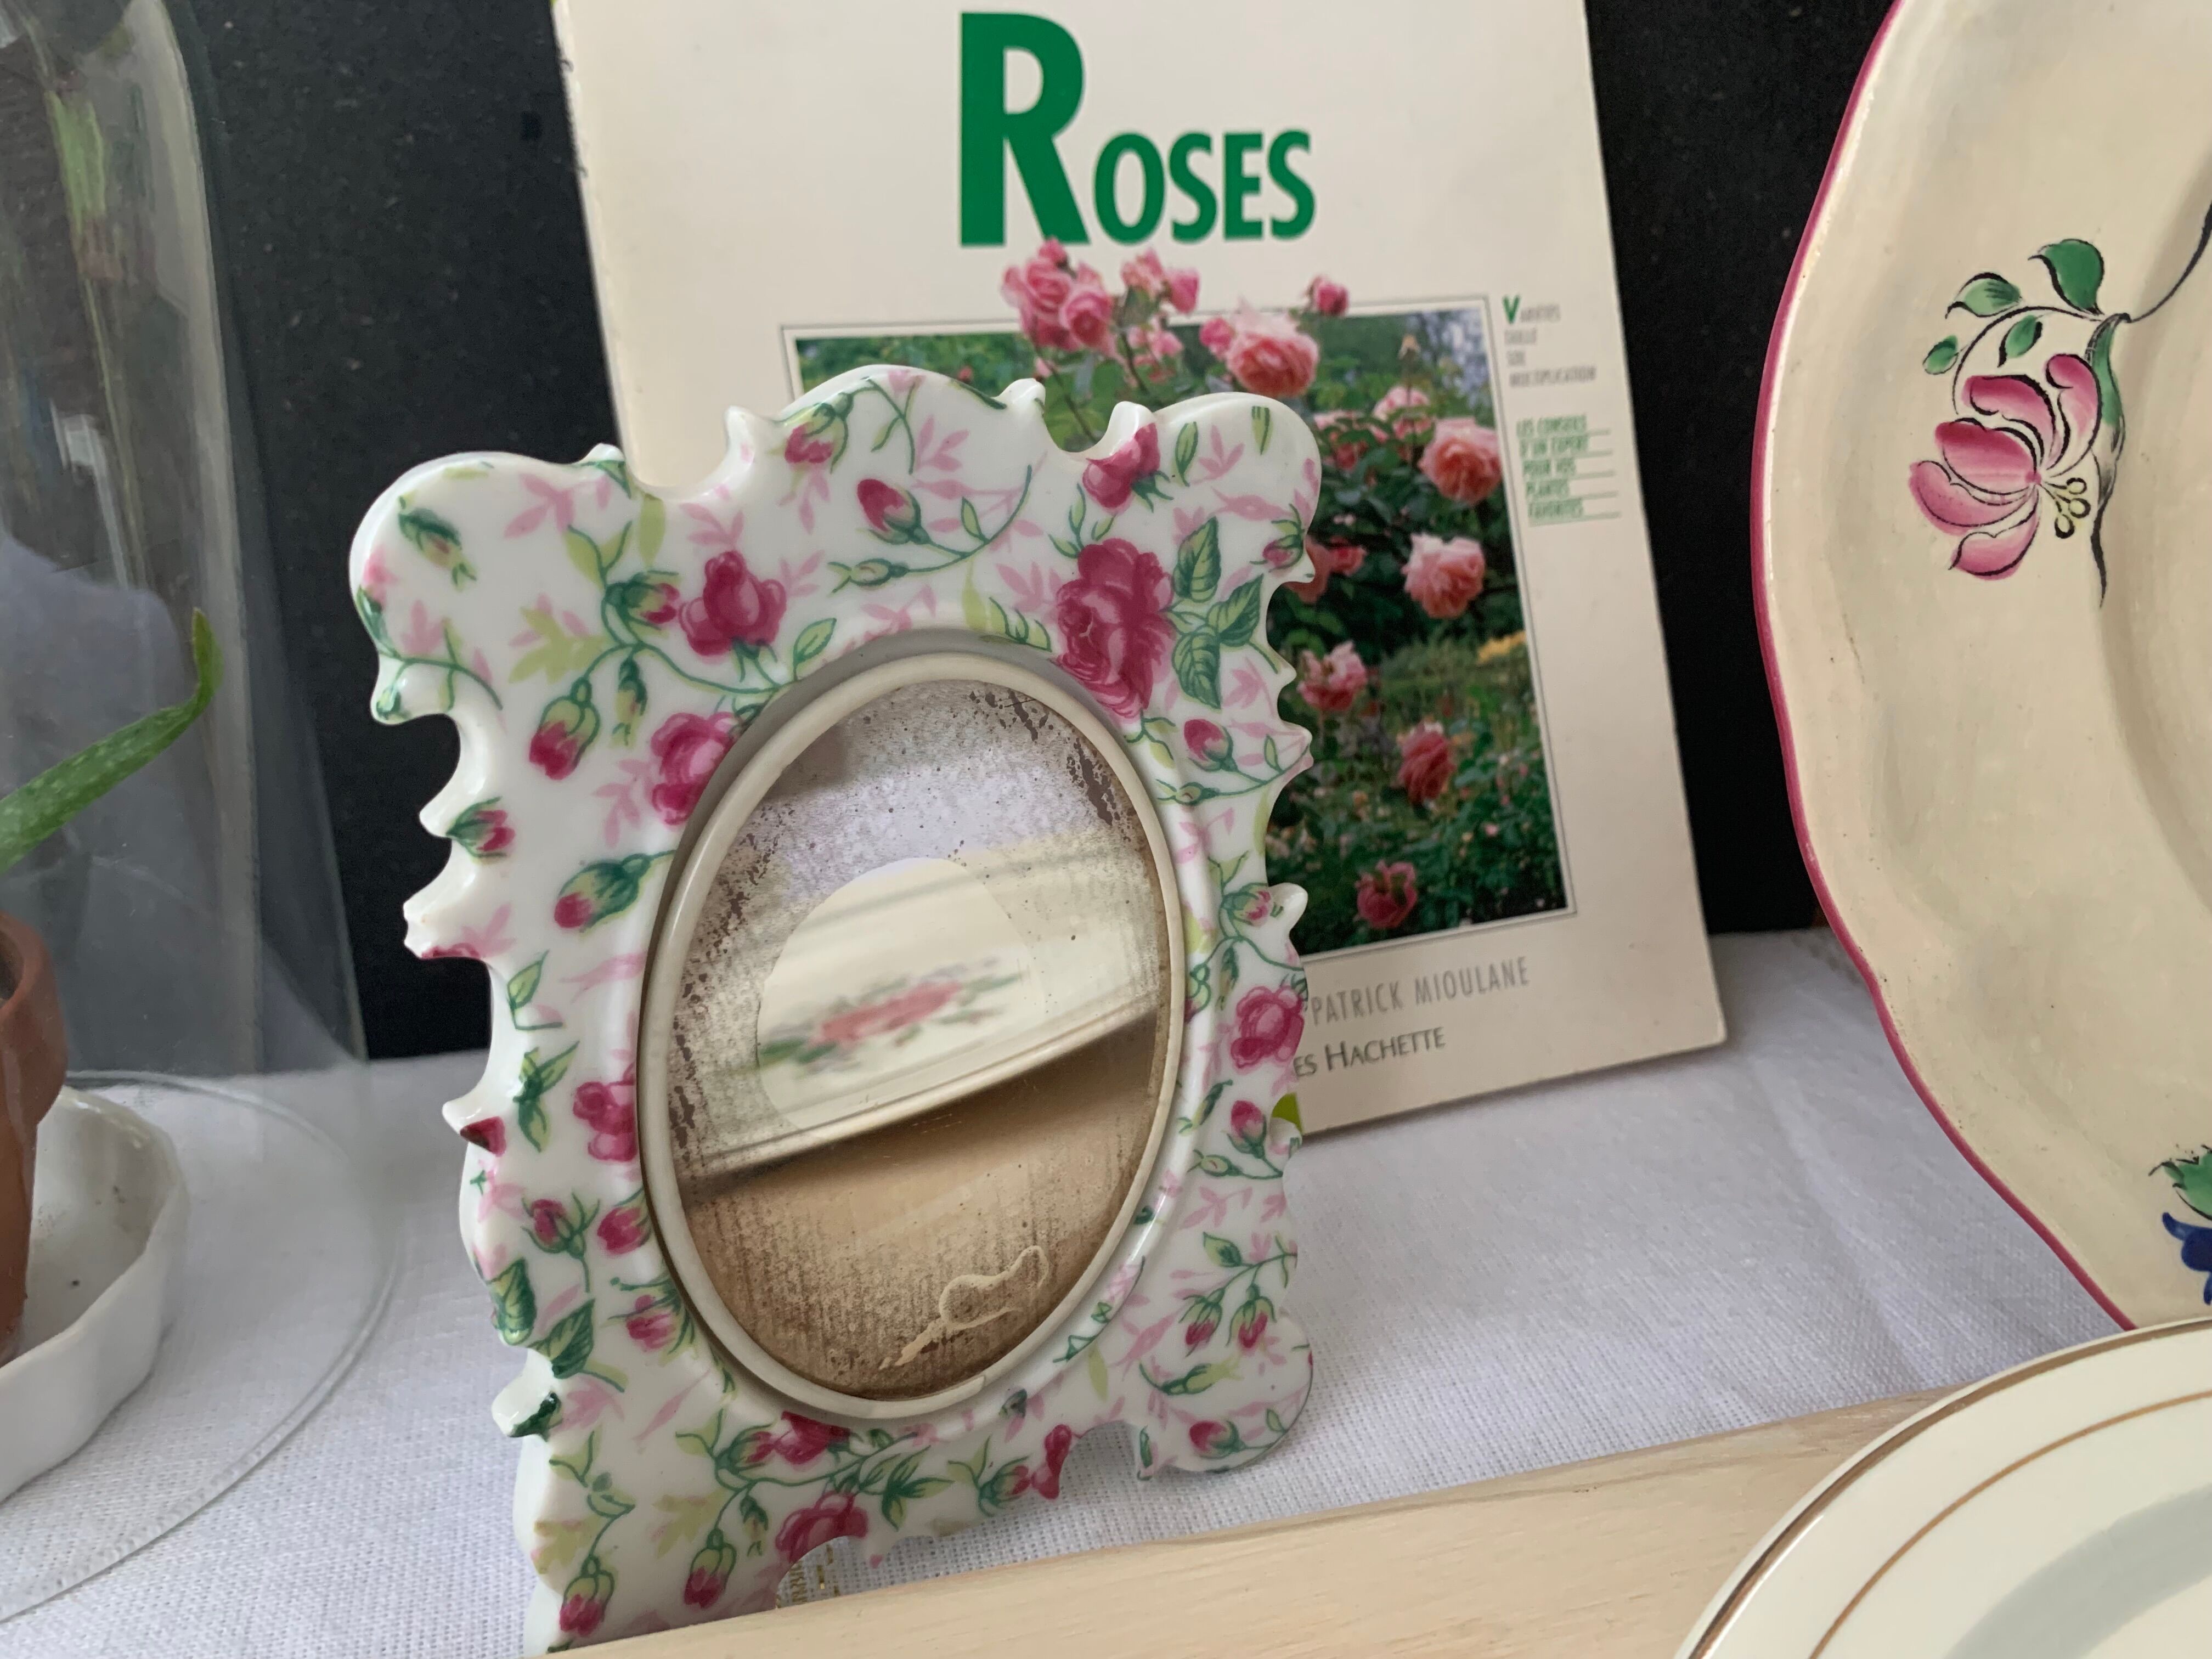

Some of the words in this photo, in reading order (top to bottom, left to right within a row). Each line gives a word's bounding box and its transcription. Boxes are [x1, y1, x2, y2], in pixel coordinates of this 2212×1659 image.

[960, 12, 1316, 247] ROSES
[1311, 980, 1403, 1026] PATRICK
[1414, 956, 1530, 1005] MIOULANE
[1325, 1026, 1446, 1071] HACHETTE
